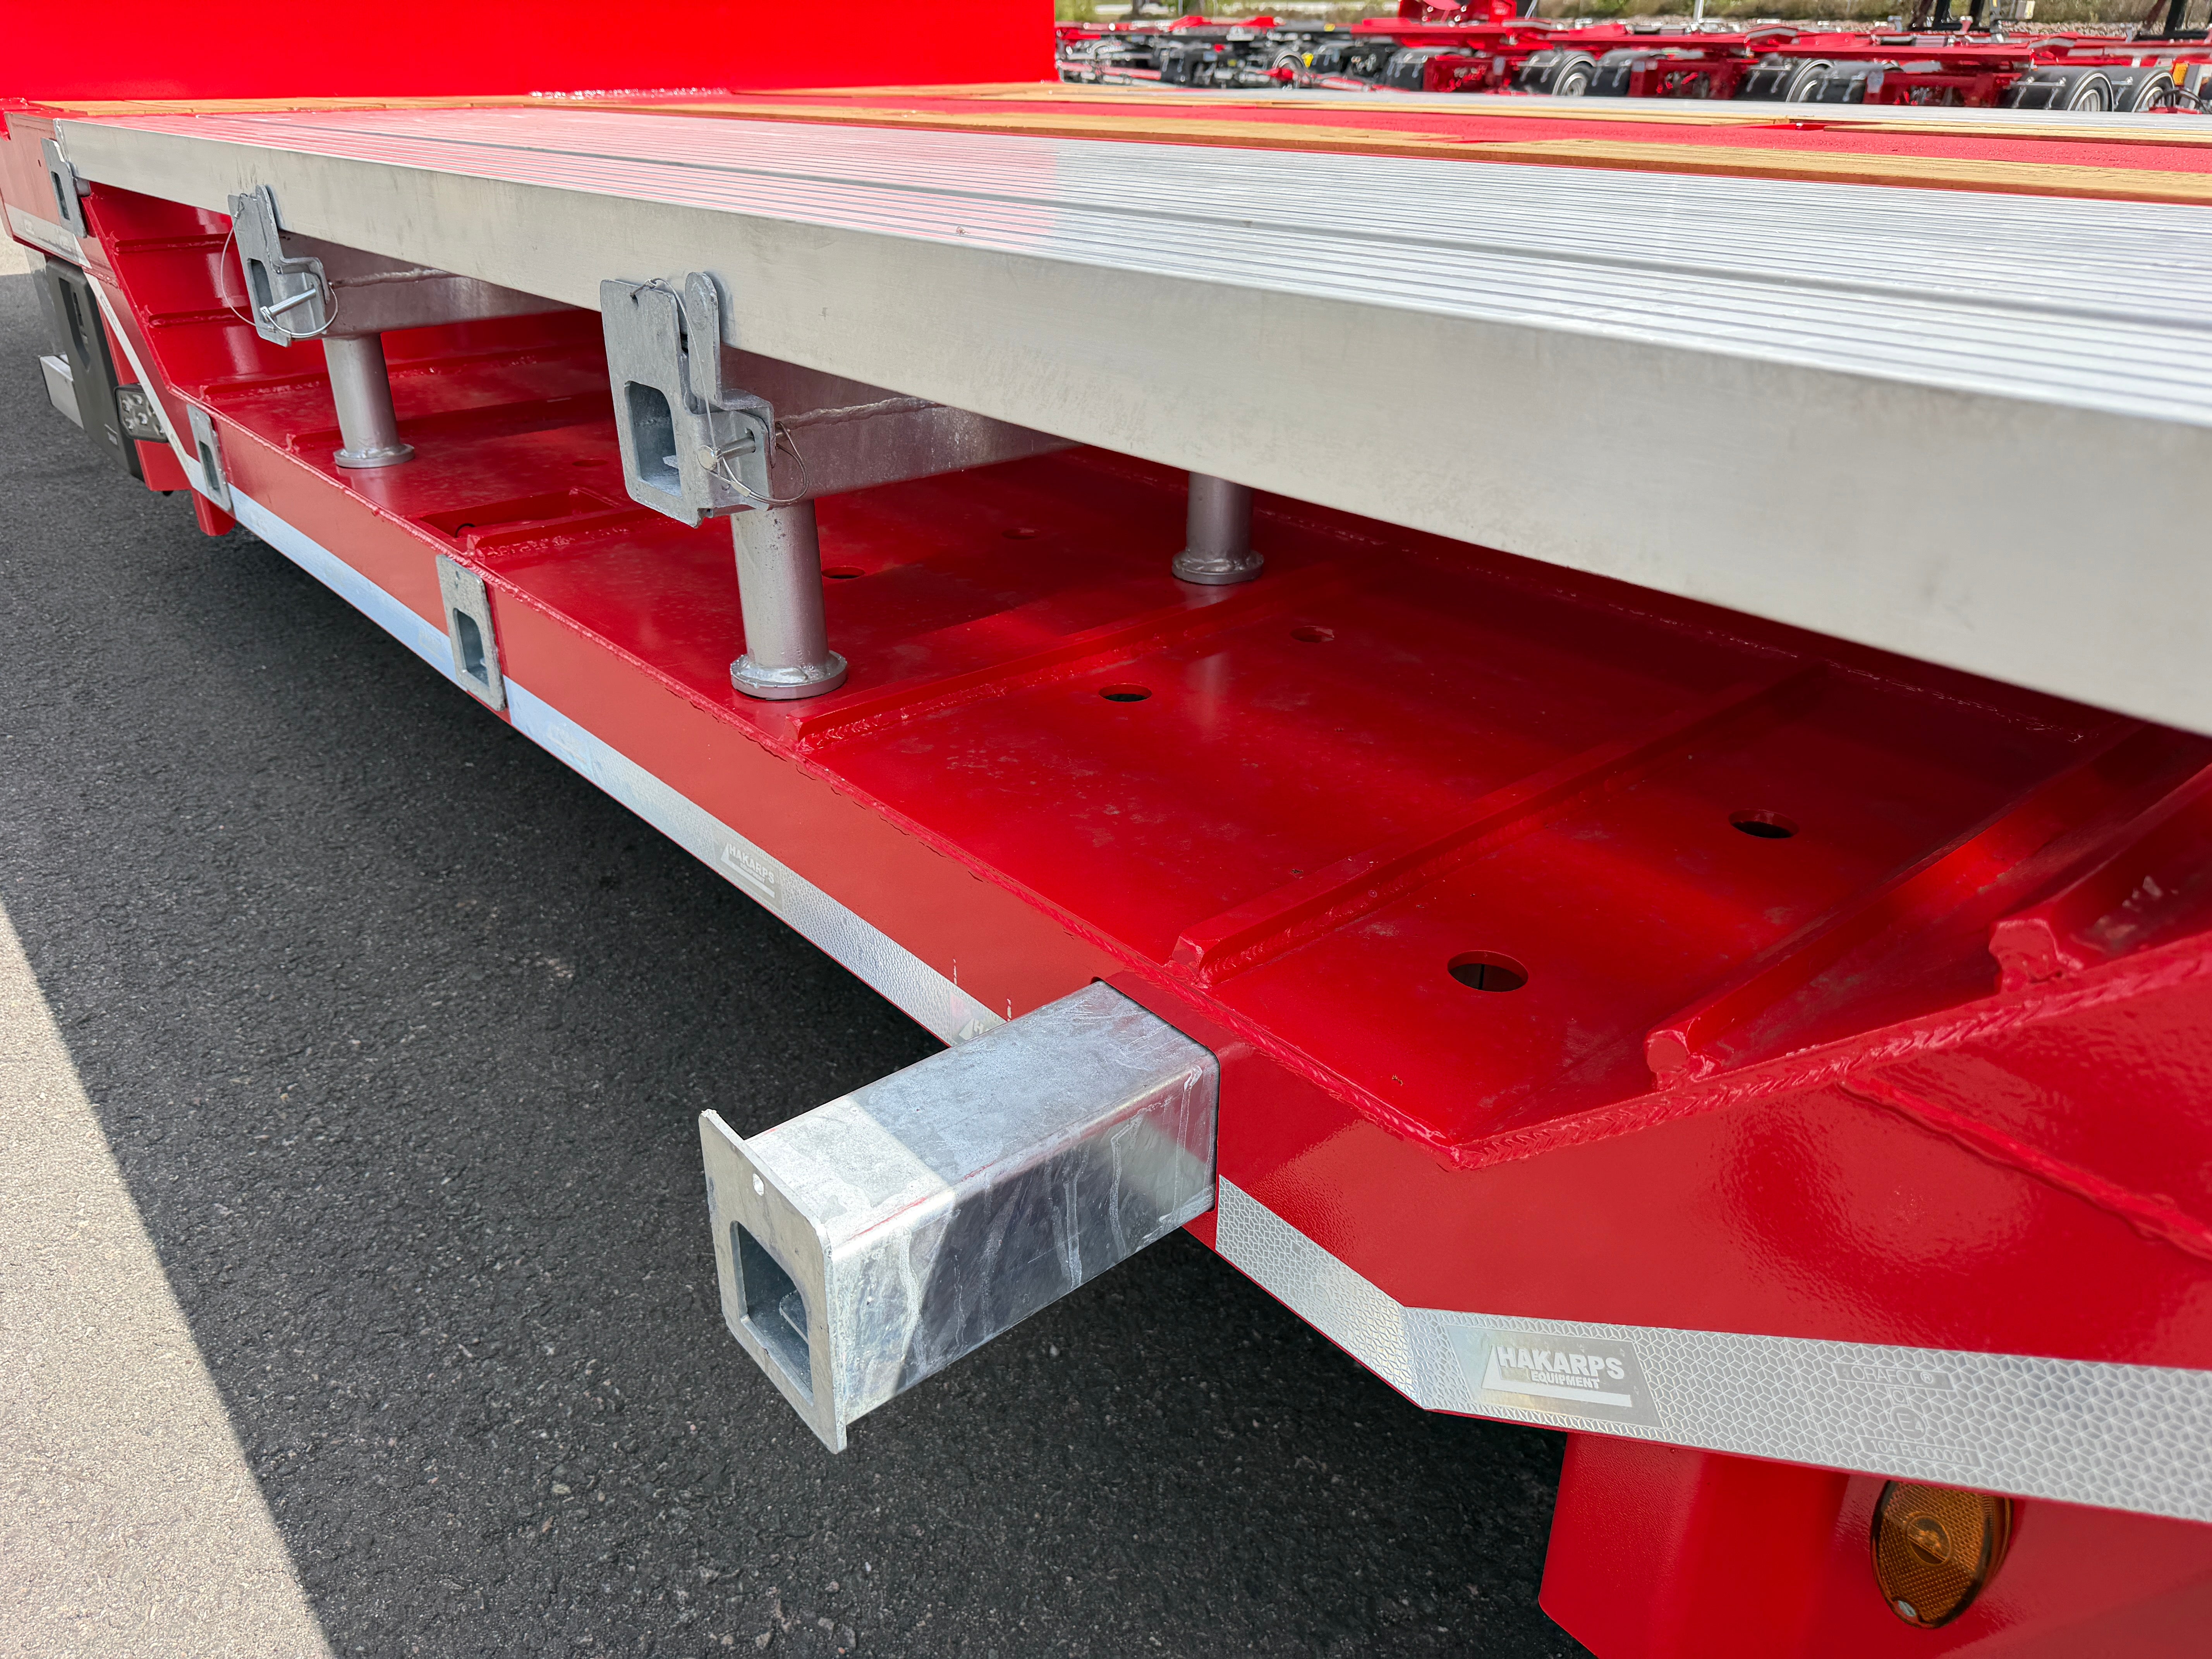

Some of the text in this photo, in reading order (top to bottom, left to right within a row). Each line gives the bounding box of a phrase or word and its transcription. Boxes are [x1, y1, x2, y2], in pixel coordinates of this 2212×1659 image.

[729, 844, 775, 883] HAKARPS
[1497, 1345, 1625, 1379] HAKARPS
[1532, 1371, 1599, 1388] EQUIPMENT
